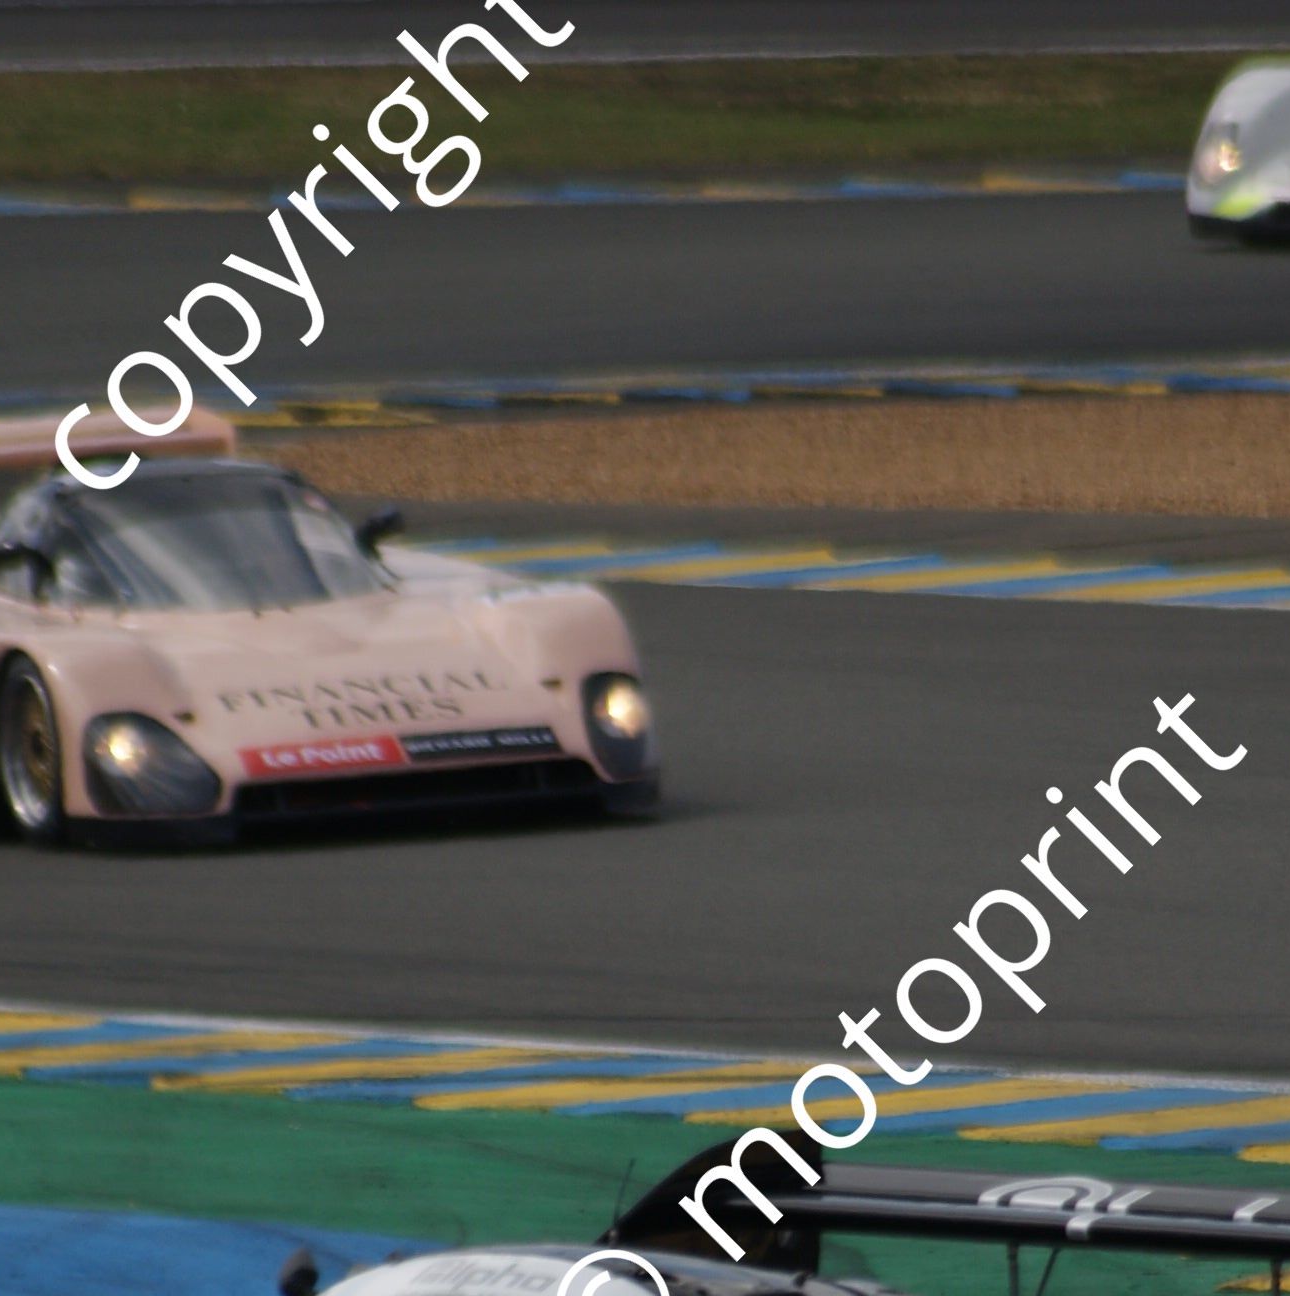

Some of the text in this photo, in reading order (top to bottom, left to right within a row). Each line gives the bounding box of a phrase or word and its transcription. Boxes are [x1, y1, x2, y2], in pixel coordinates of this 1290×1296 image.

[216, 670, 506, 713] FINANCIAL
[301, 699, 463, 729] TIMES
[260, 742, 385, 769] Le Point
